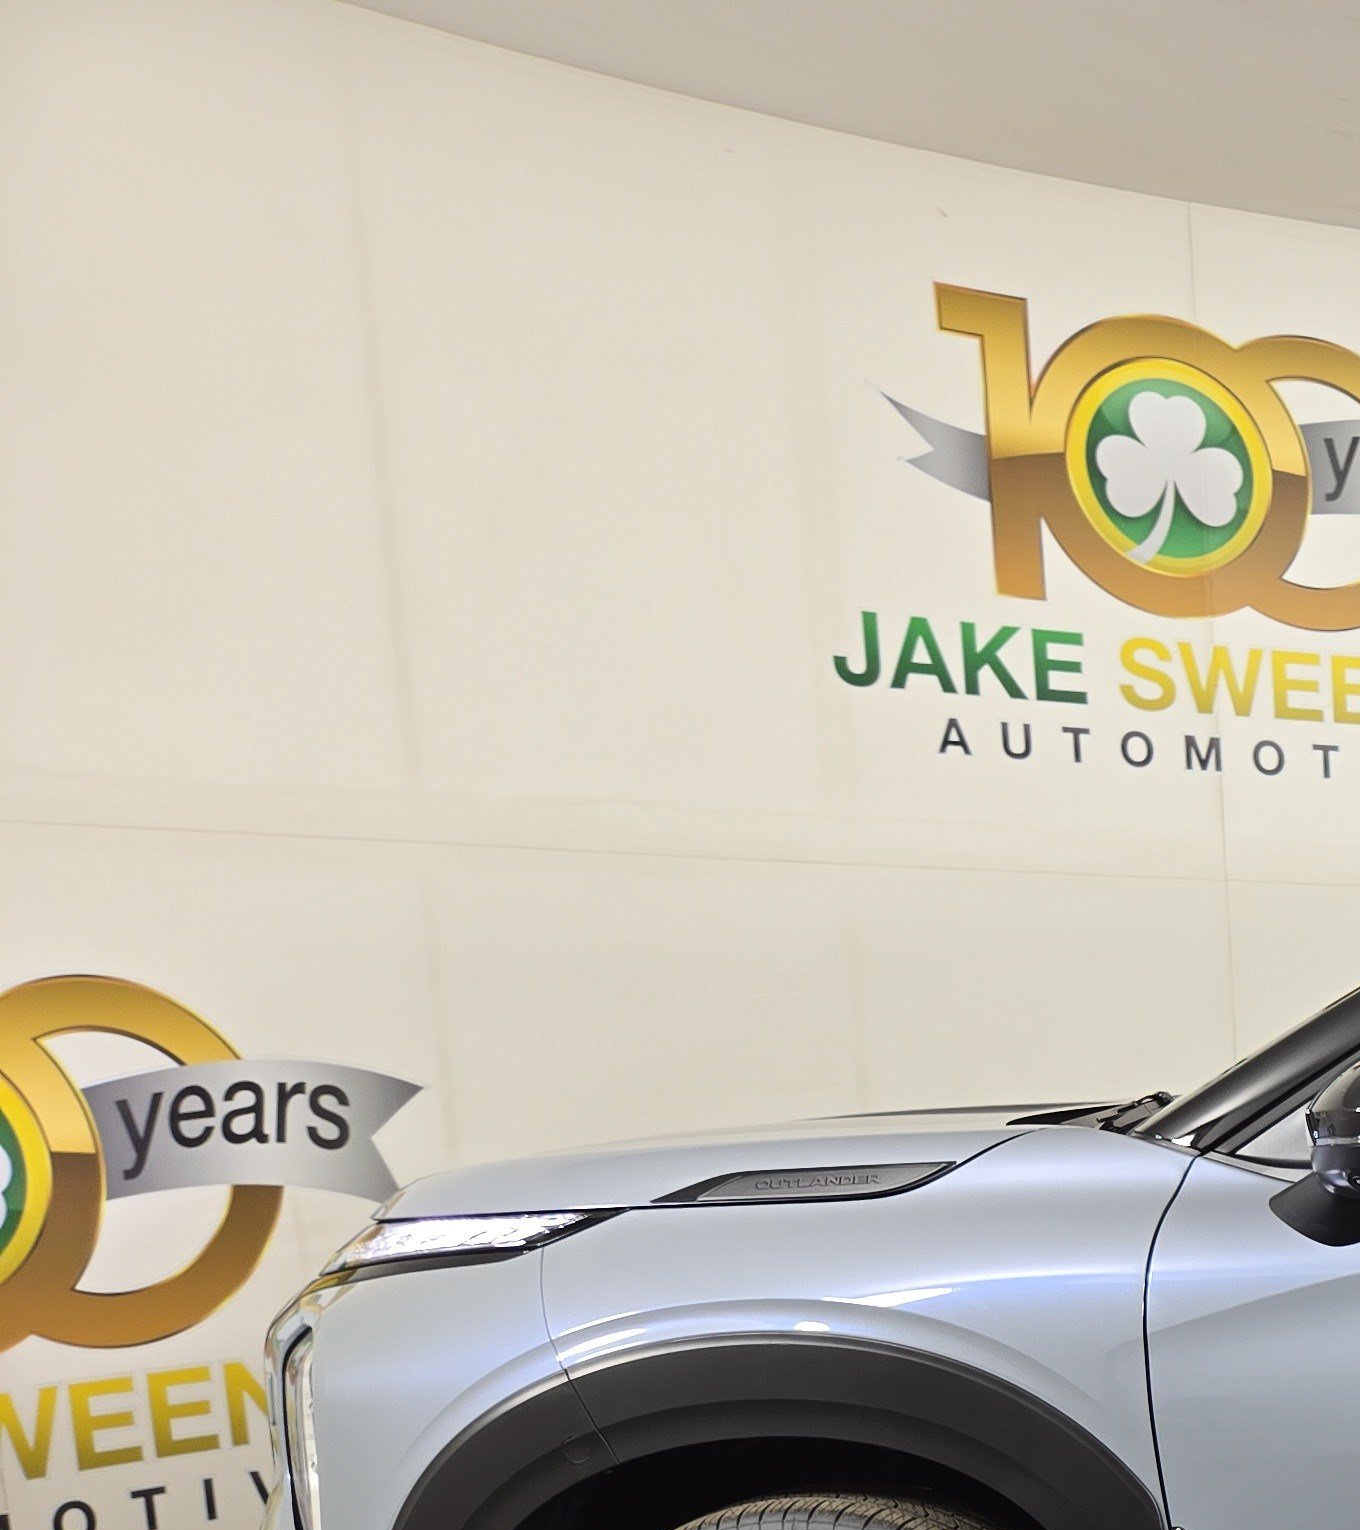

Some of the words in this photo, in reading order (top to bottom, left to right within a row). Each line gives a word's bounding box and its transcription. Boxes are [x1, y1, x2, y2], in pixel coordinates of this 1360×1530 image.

[833, 611, 1088, 705] JAKE
[116, 1080, 352, 1181] years
[755, 1173, 881, 1191] OUTLANDER
